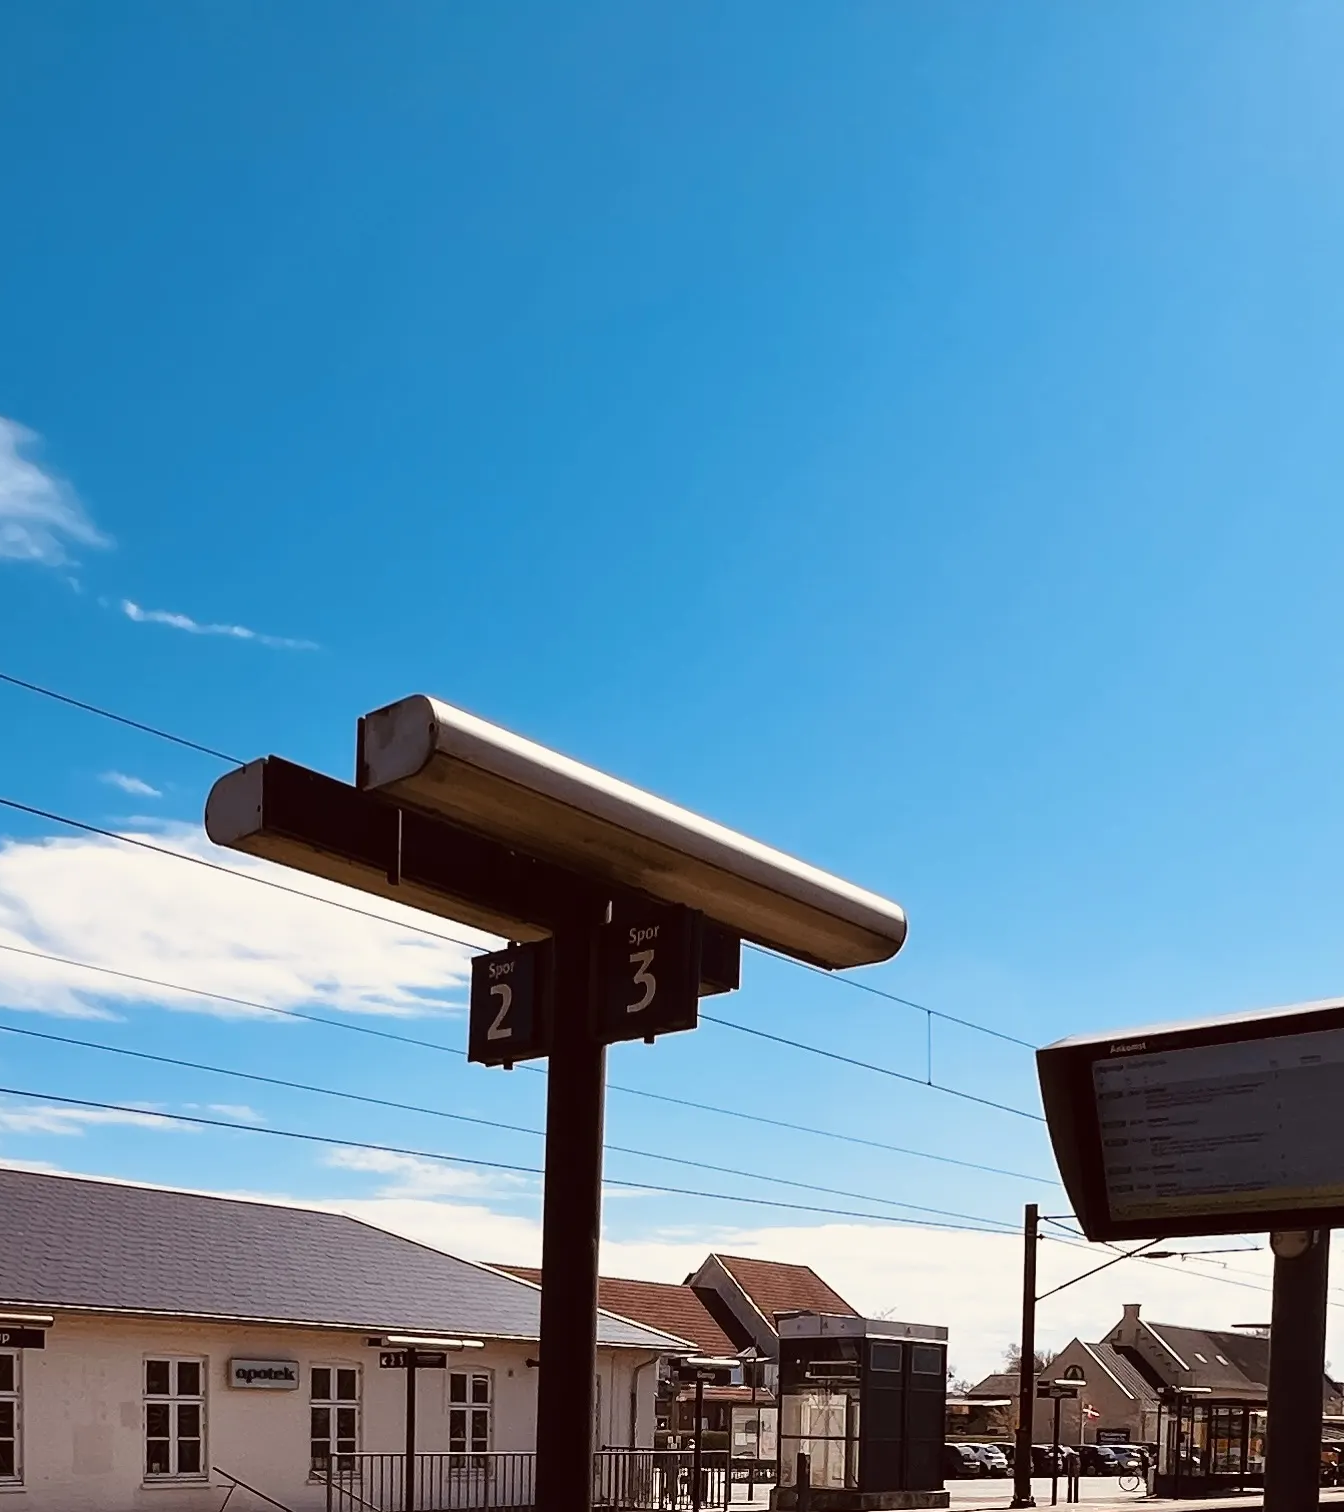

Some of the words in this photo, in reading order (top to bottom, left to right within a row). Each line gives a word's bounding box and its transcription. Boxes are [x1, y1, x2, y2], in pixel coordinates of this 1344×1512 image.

[628, 924, 660, 946] Spor
[488, 959, 515, 979] Spor
[625, 948, 657, 1013] 3
[487, 983, 513, 1041] 2
[1109, 1041, 1147, 1054] Ankomst
[235, 1364, 295, 1384] apotek
